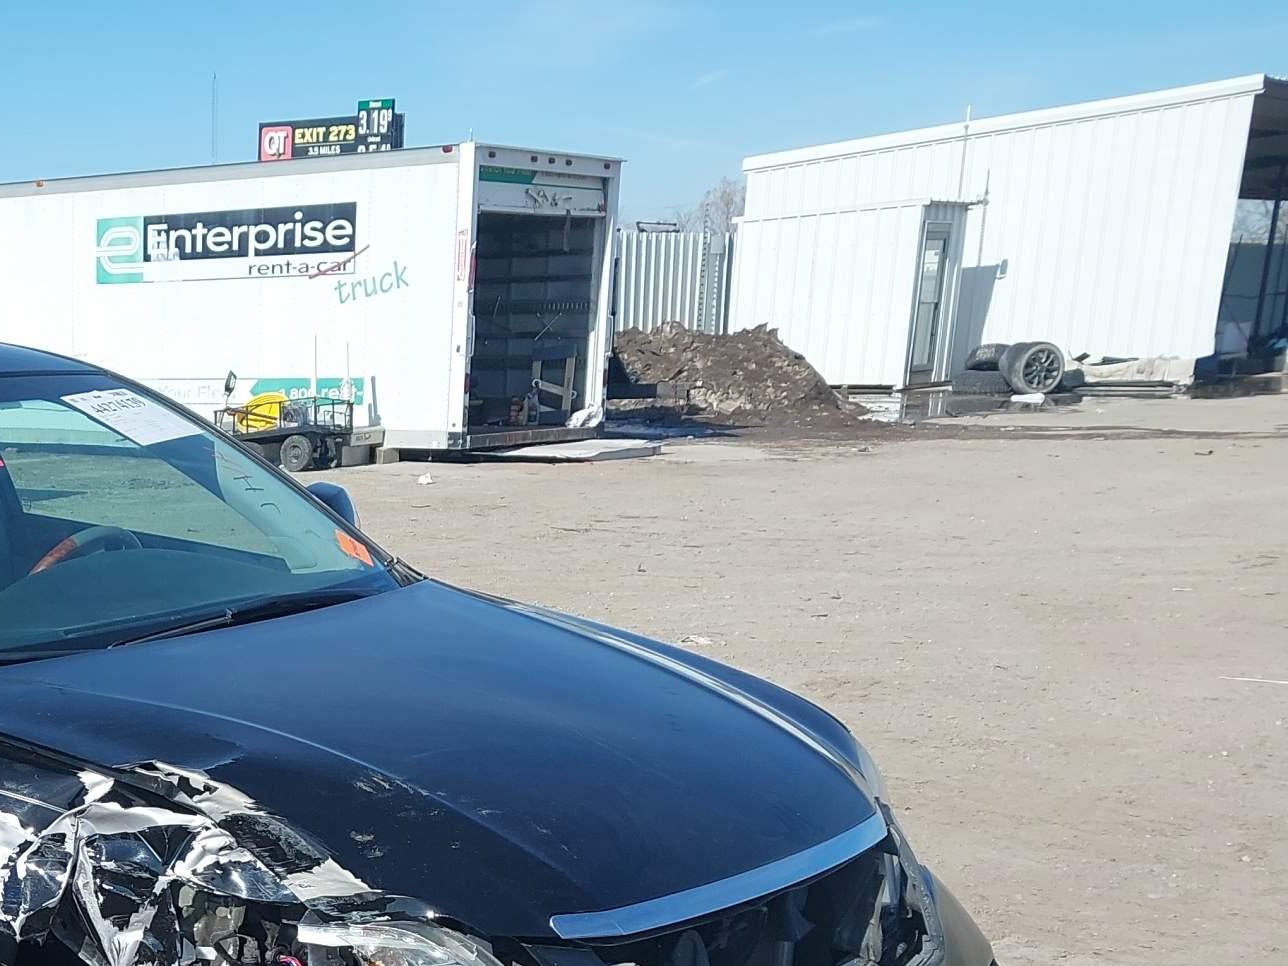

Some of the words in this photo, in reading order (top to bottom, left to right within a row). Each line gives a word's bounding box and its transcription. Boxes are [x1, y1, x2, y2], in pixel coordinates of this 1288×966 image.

[264, 131, 288, 157] QT
[294, 127, 326, 144] EXIT
[328, 124, 355, 141] 273
[320, 144, 340, 155] MILES
[146, 211, 353, 258] Enterprise
[248, 258, 352, 277] rent-a-car
[334, 261, 410, 304] truck
